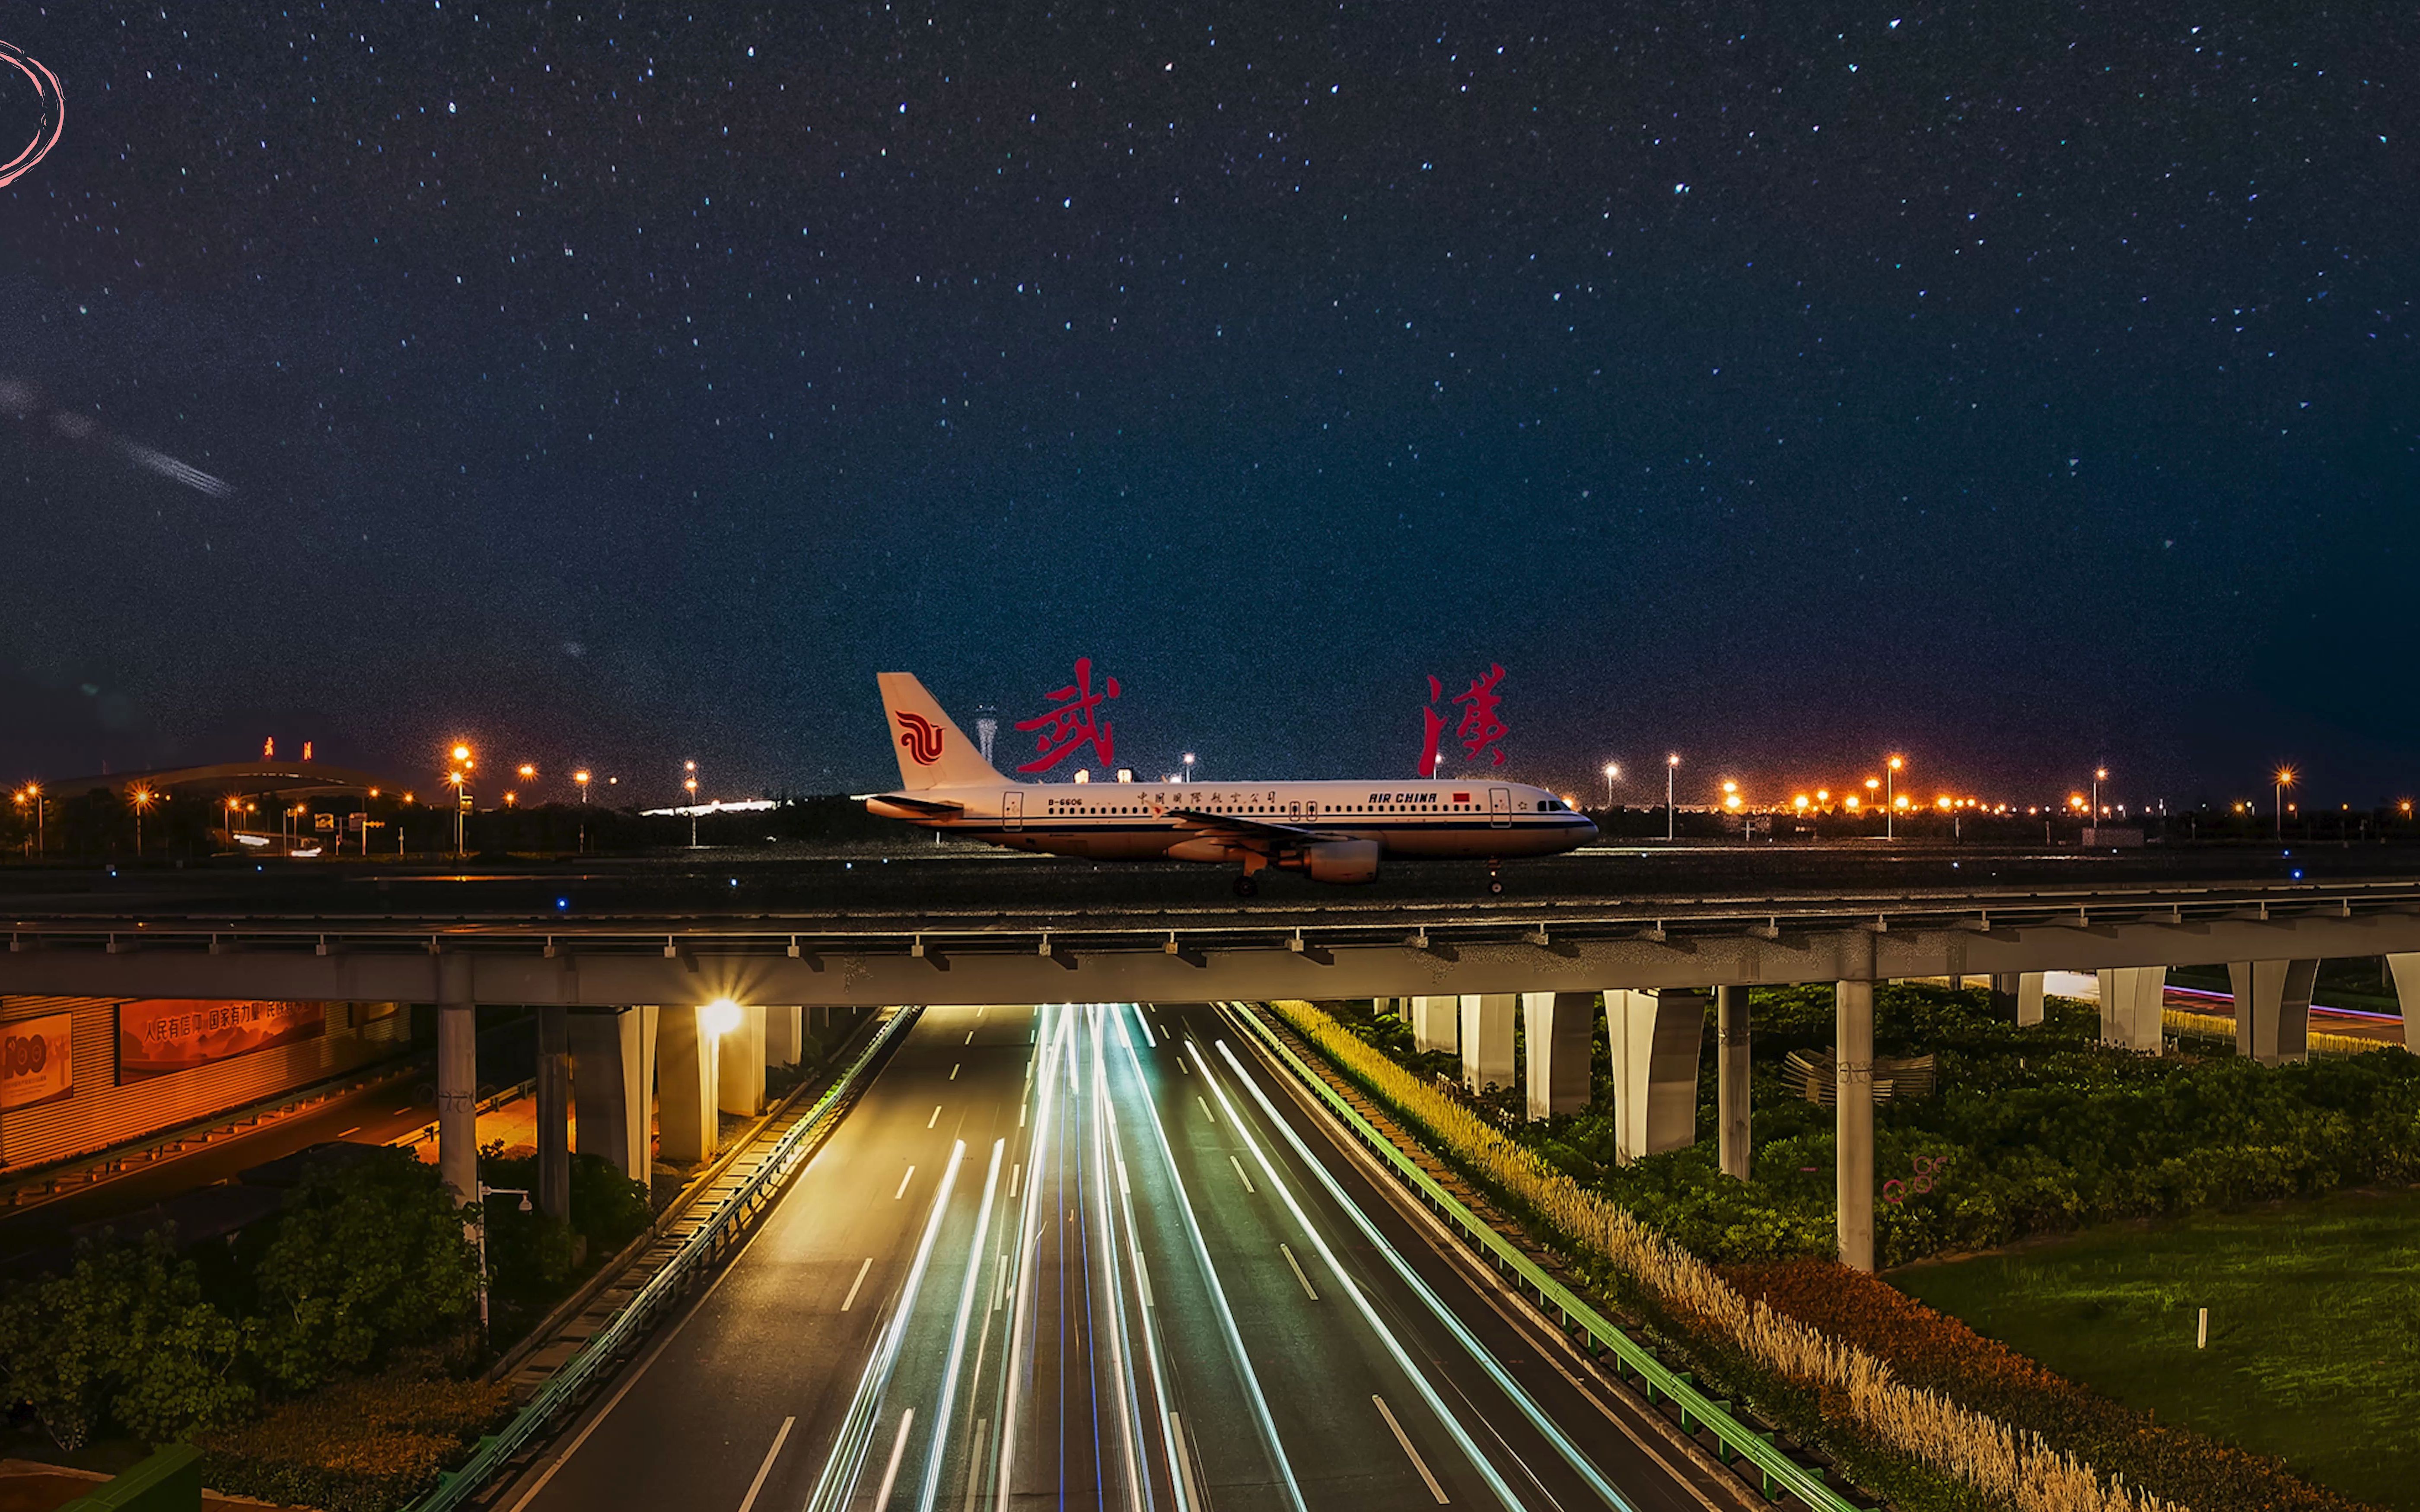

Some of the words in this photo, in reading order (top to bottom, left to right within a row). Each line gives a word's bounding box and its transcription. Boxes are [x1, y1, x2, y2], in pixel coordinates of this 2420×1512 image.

[1369, 793, 1391, 803] AIR
[1396, 793, 1437, 803] CHINA
[145, 1014, 201, 1041] 人民有信仰
